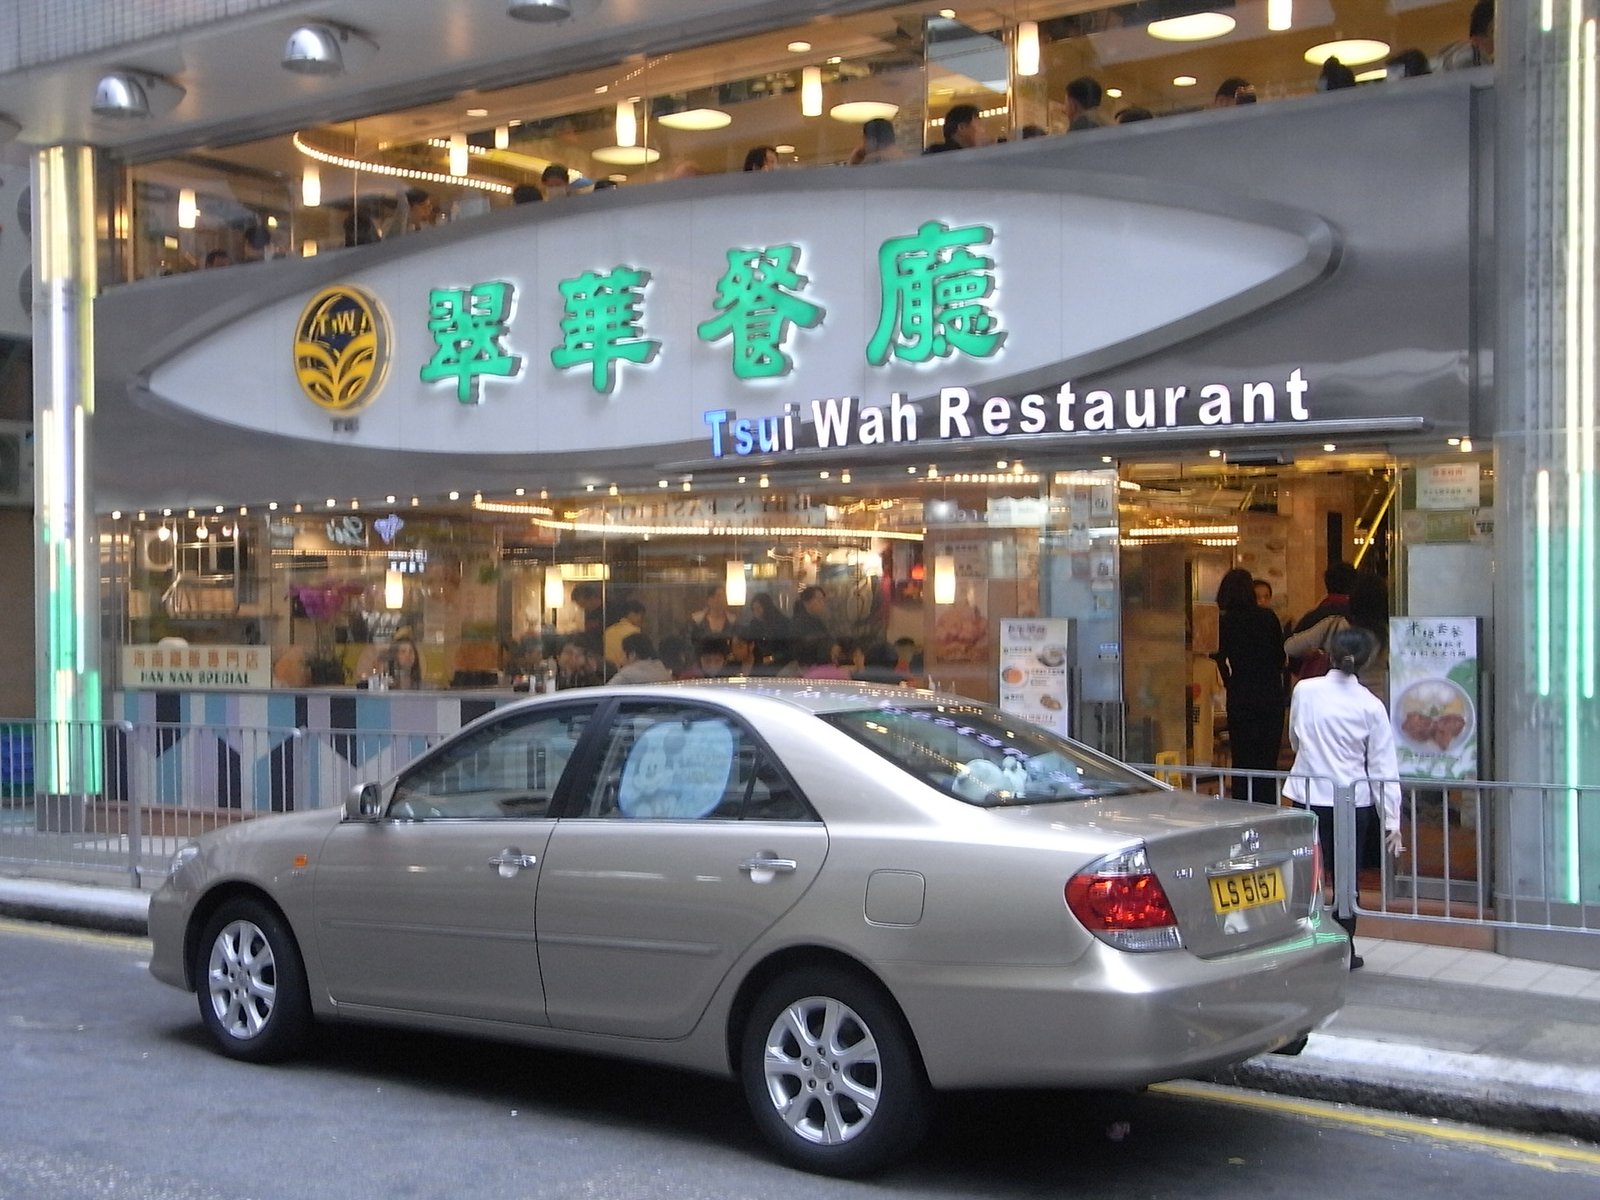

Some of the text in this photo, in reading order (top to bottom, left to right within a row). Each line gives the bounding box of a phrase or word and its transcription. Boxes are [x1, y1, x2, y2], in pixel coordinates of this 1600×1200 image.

[420, 221, 1007, 404] 翠華餐廳
[704, 368, 1309, 458] Tsui Wah Restaurant
[199, 671, 249, 684] SPECIAL
[1217, 872, 1276, 908] LS 5157
